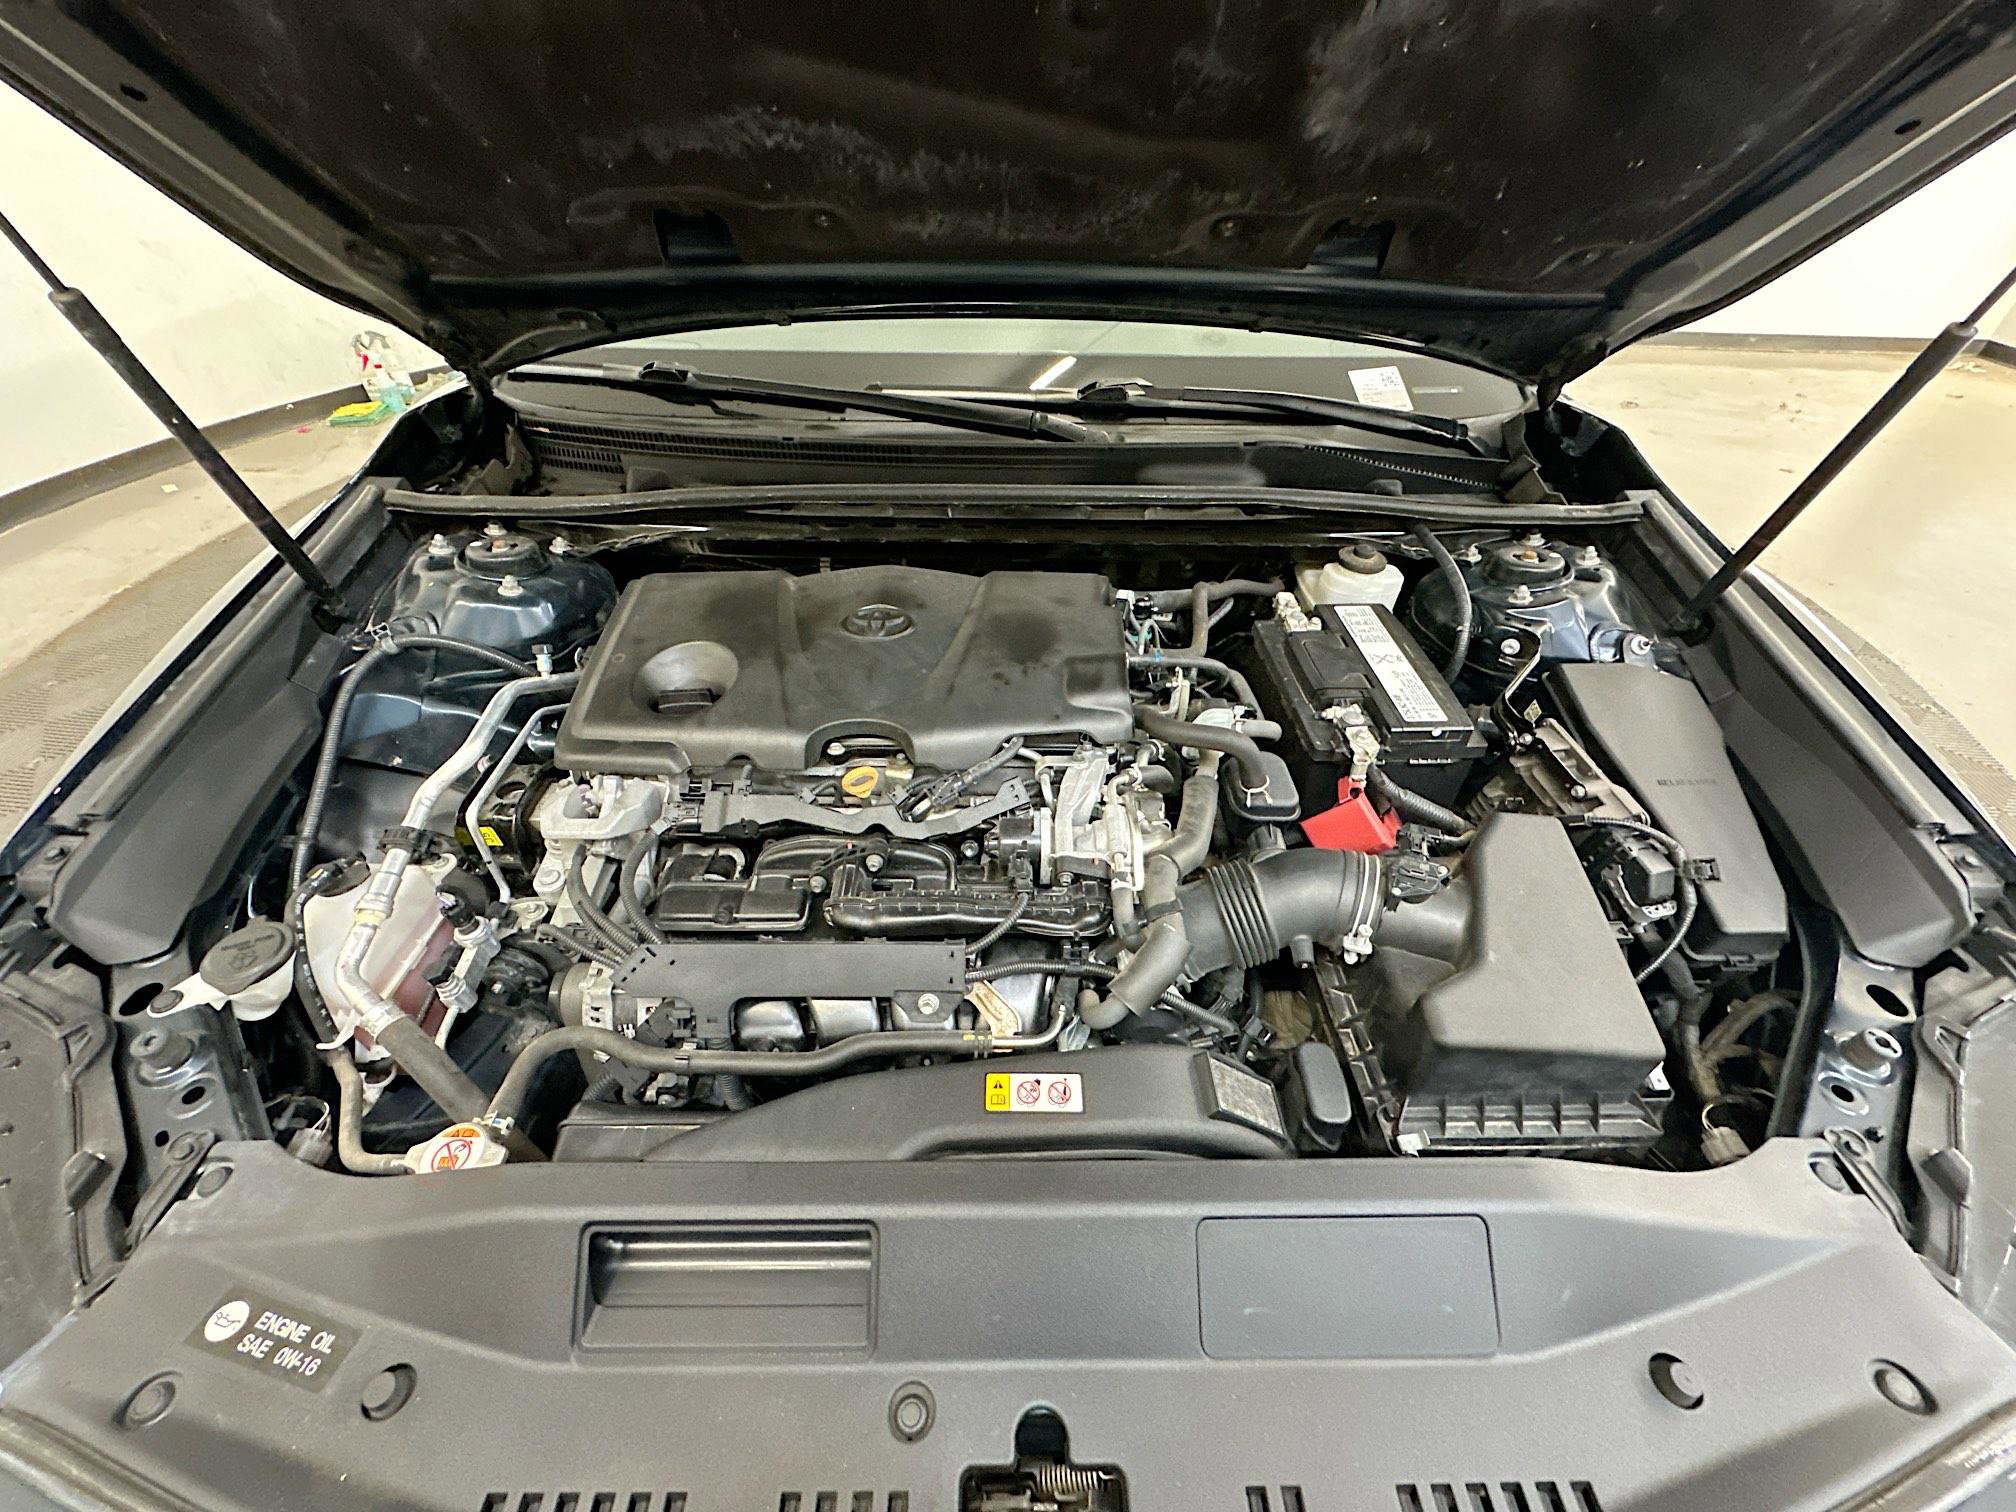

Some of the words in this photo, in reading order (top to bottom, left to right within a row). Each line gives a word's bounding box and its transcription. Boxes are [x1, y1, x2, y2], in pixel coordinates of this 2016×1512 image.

[254, 1311, 311, 1343] ENGINE
[310, 1331, 336, 1354] OIL
[236, 1333, 274, 1359] SAE
[273, 1346, 322, 1376] 0W-16
